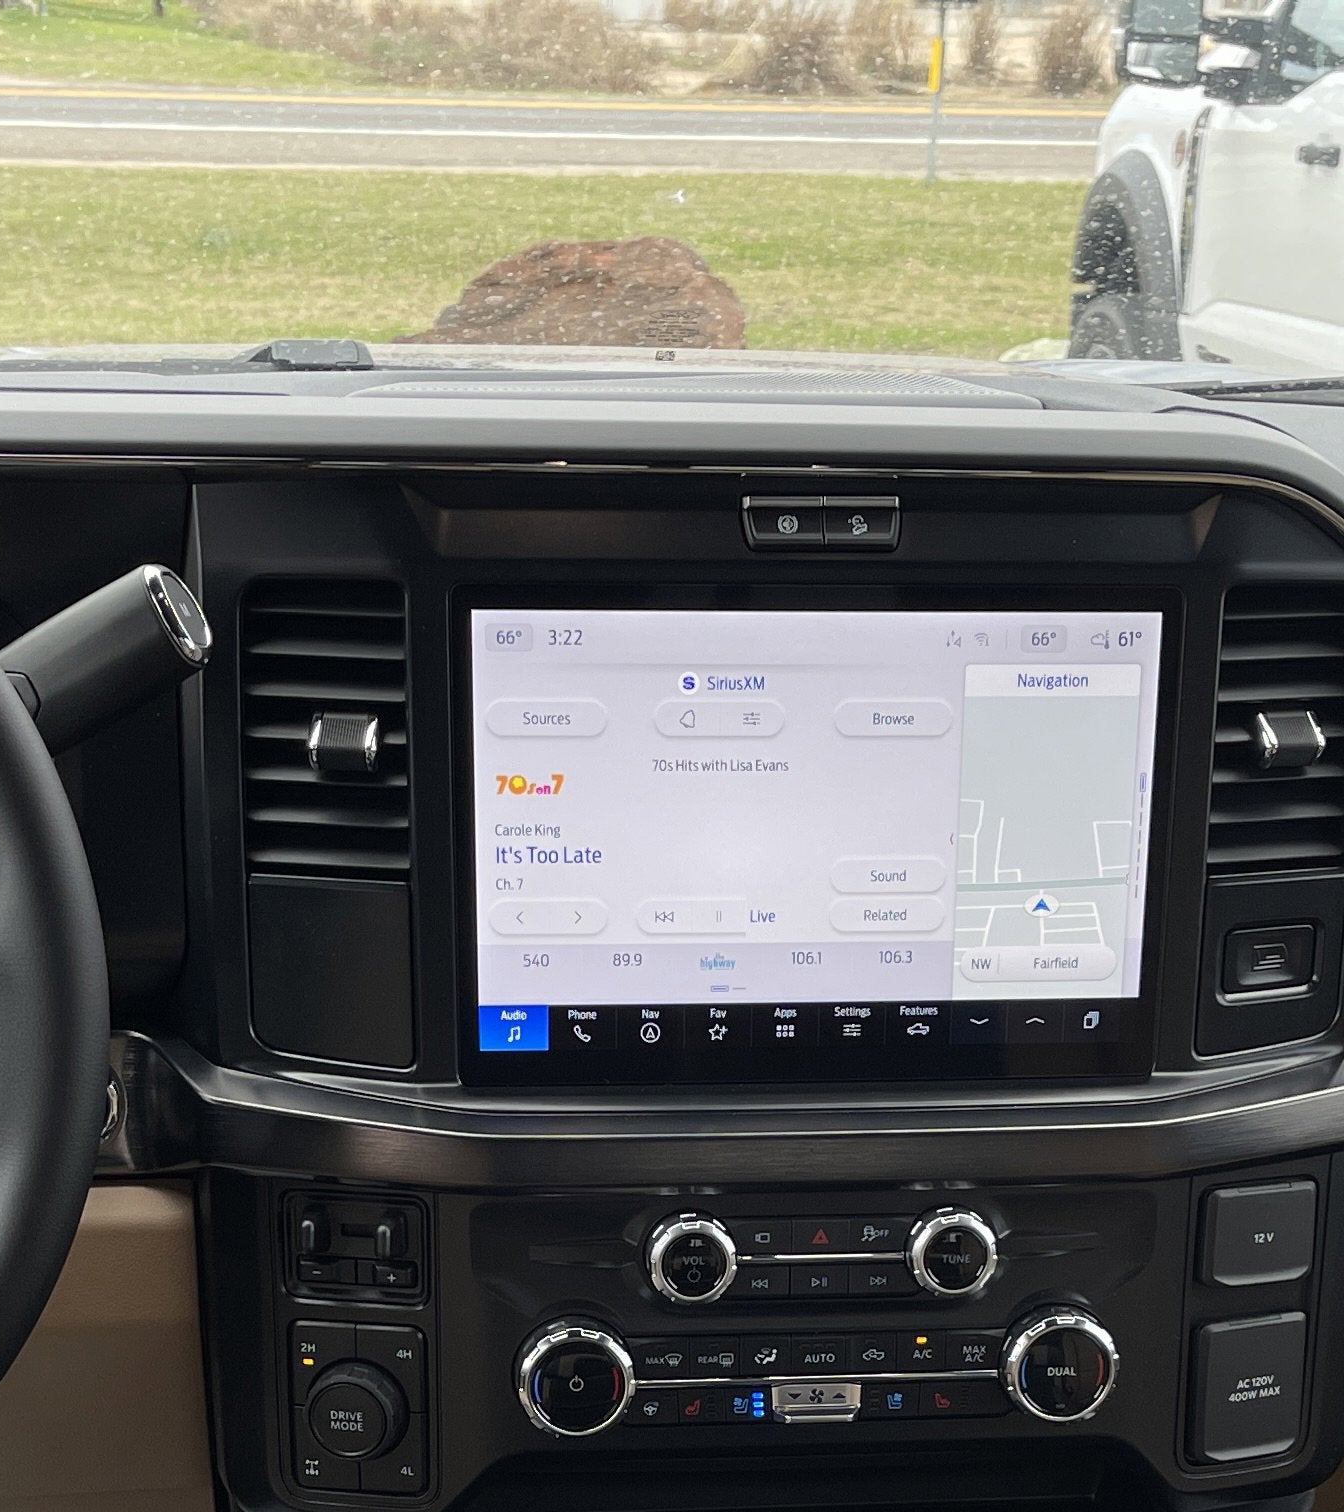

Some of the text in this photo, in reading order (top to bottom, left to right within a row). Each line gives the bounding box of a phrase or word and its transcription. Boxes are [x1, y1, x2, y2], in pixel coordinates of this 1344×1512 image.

[548, 630, 583, 646] 3:22
[707, 676, 765, 691] SiriusXM
[1017, 673, 1089, 690] Navigation
[523, 712, 571, 726] Sources
[872, 712, 915, 726] Browse
[652, 758, 789, 773] 70s Hits with Lisa Evans
[495, 824, 561, 839] Carole King
[496, 846, 602, 864] It's Too Late
[870, 870, 907, 882] Sound
[495, 878, 524, 890] Ch. 7
[750, 910, 776, 923] Live
[863, 909, 907, 922] Related
[522, 954, 550, 968] 540
[612, 953, 643, 967] 89.9
[791, 952, 822, 965] 106.1
[878, 951, 913, 965] 106.3
[971, 958, 991, 970] NW
[1033, 957, 1079, 969] Fairfield
[501, 1010, 527, 1020] Audio
[567, 1009, 597, 1020] Phone
[641, 1009, 660, 1020] Nav
[709, 1008, 727, 1019] Fav
[774, 1007, 797, 1020] Apps
[834, 1006, 871, 1019] Settings
[899, 1005, 938, 1016] Features
[874, 1228, 890, 1238] OFF
[682, 1255, 706, 1266] VOL
[942, 1254, 971, 1265] TUNE
[300, 1343, 316, 1353] 2H
[963, 1345, 986, 1355] MAX
[396, 1349, 412, 1360] 4H
[698, 1355, 719, 1364] REAR
[804, 1353, 835, 1364] AUTO
[912, 1350, 932, 1360] A/C
[964, 1353, 984, 1364] A/C
[645, 1356, 666, 1366] MAX
[1047, 1366, 1077, 1377] DUAL
[1236, 1375, 1275, 1389] AC 120V
[1228, 1386, 1281, 1402] 400W MAX
[330, 1410, 364, 1422] DRIVE
[330, 1420, 364, 1432] MODE
[400, 1466, 414, 1476] 4L
